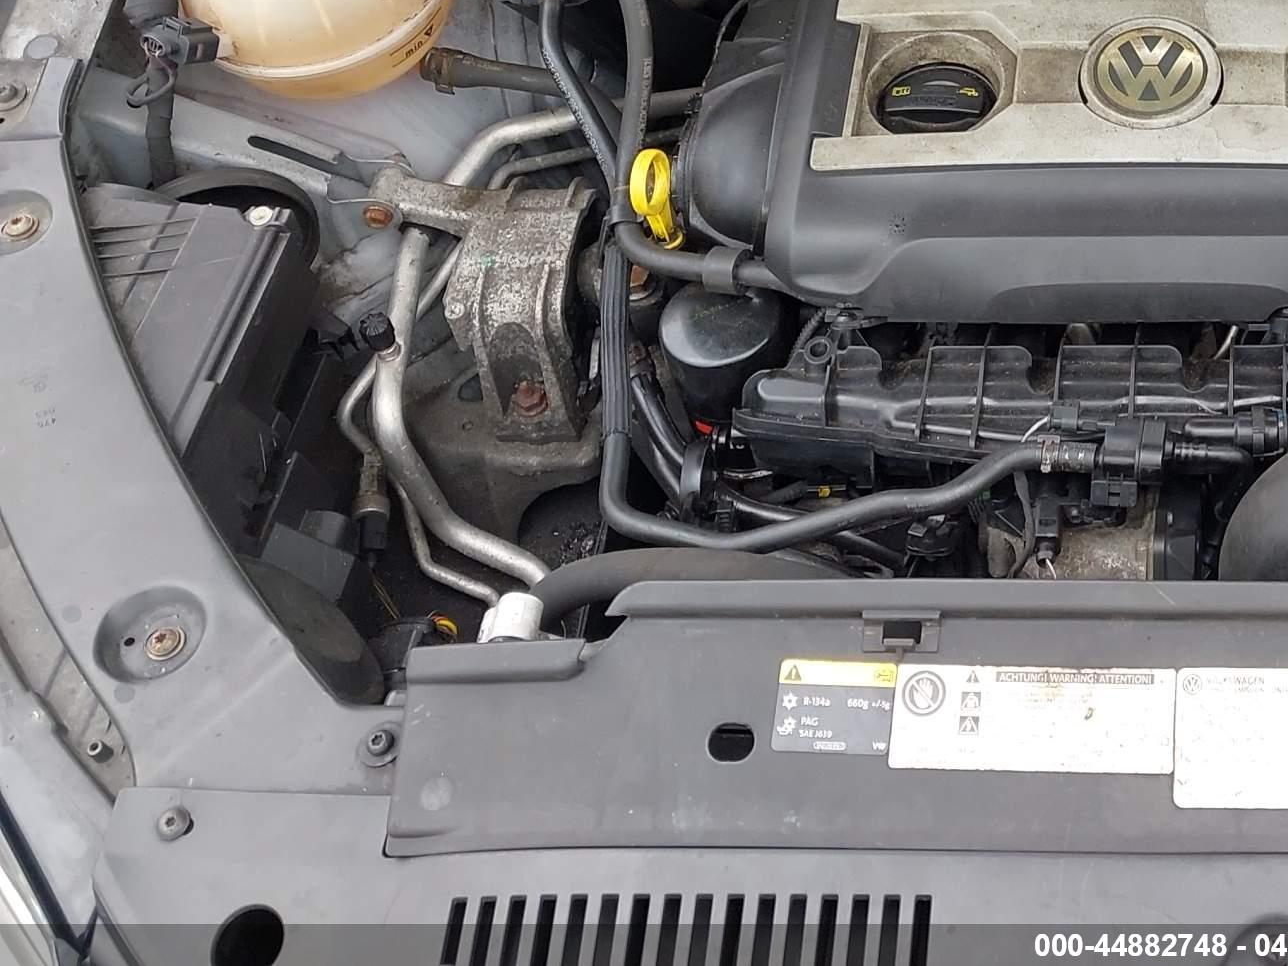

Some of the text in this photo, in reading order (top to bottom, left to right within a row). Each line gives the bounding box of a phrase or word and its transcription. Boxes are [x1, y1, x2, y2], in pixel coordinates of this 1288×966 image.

[404, 39, 424, 59] min
[999, 672, 1153, 685] ACHTUNG! WARNING! ATTENTION!
[800, 717, 819, 726] PAG
